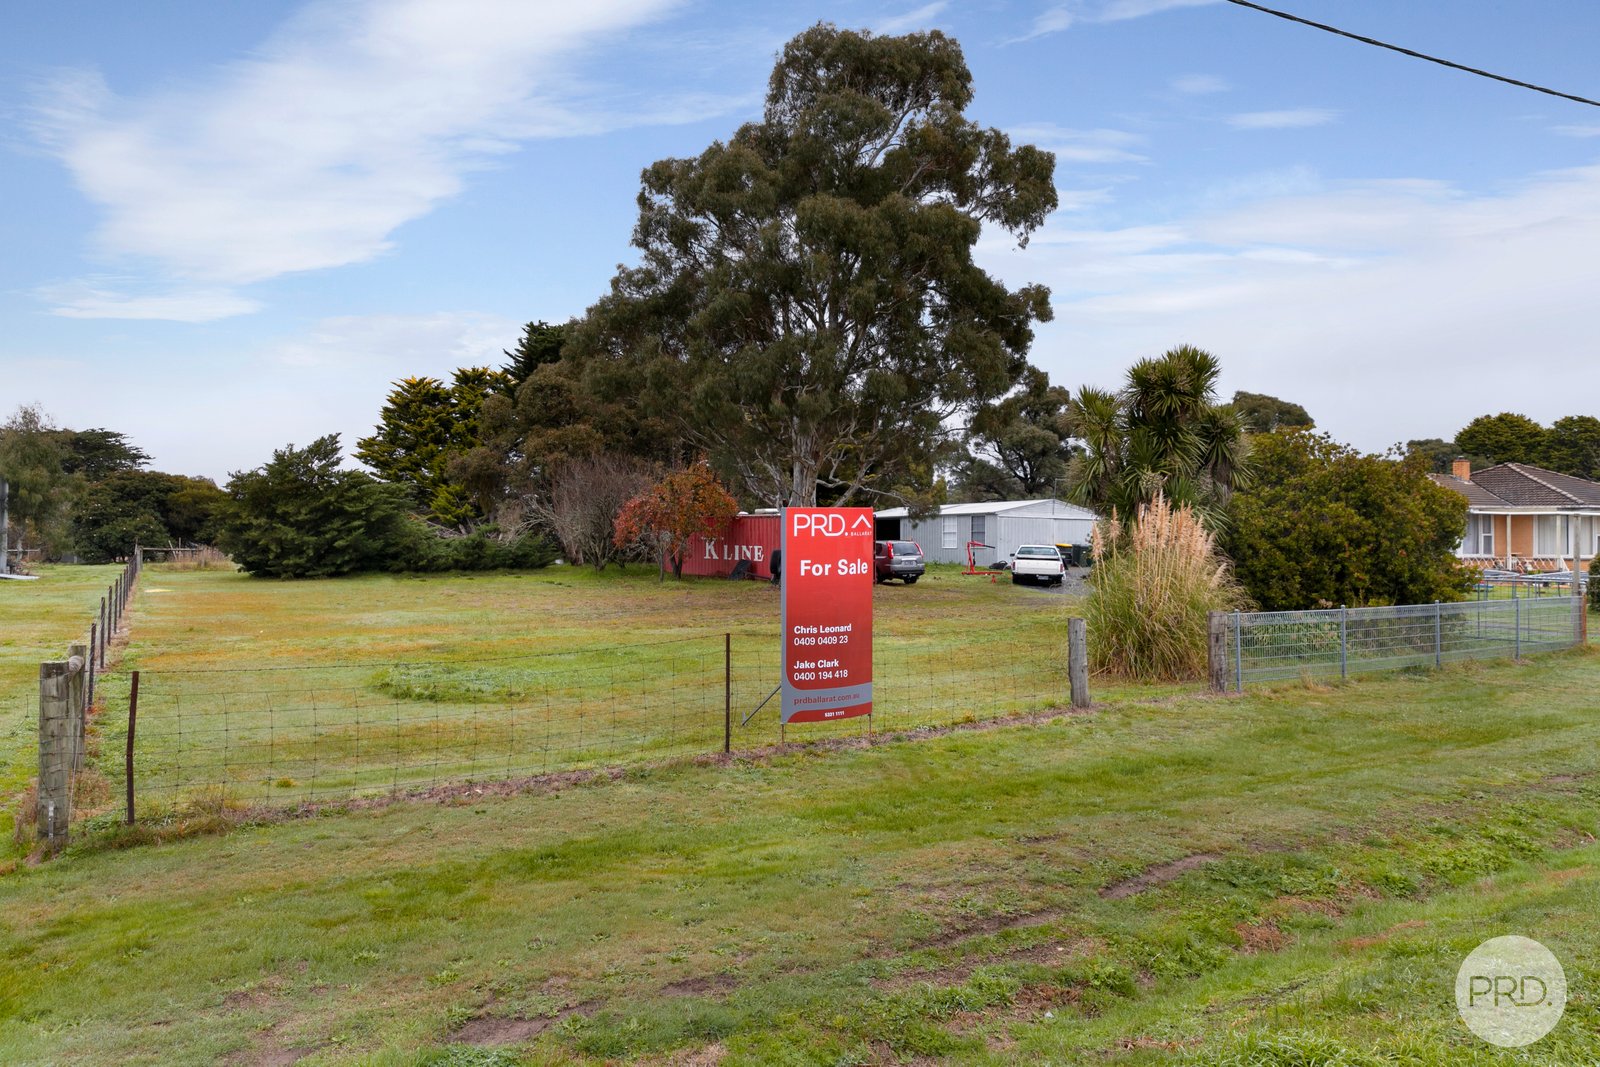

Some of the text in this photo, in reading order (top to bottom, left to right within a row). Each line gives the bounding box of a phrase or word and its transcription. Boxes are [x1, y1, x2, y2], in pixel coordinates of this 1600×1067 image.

[723, 544, 764, 562] LINE
[800, 558, 868, 576] For Sale
[793, 623, 852, 634] Chris Leonard
[793, 635, 849, 646] 0409 0409 23
[793, 658, 839, 669] Jake Clark
[793, 669, 848, 681] 0400 194 418
[793, 693, 860, 706] prdballarat.com.au
